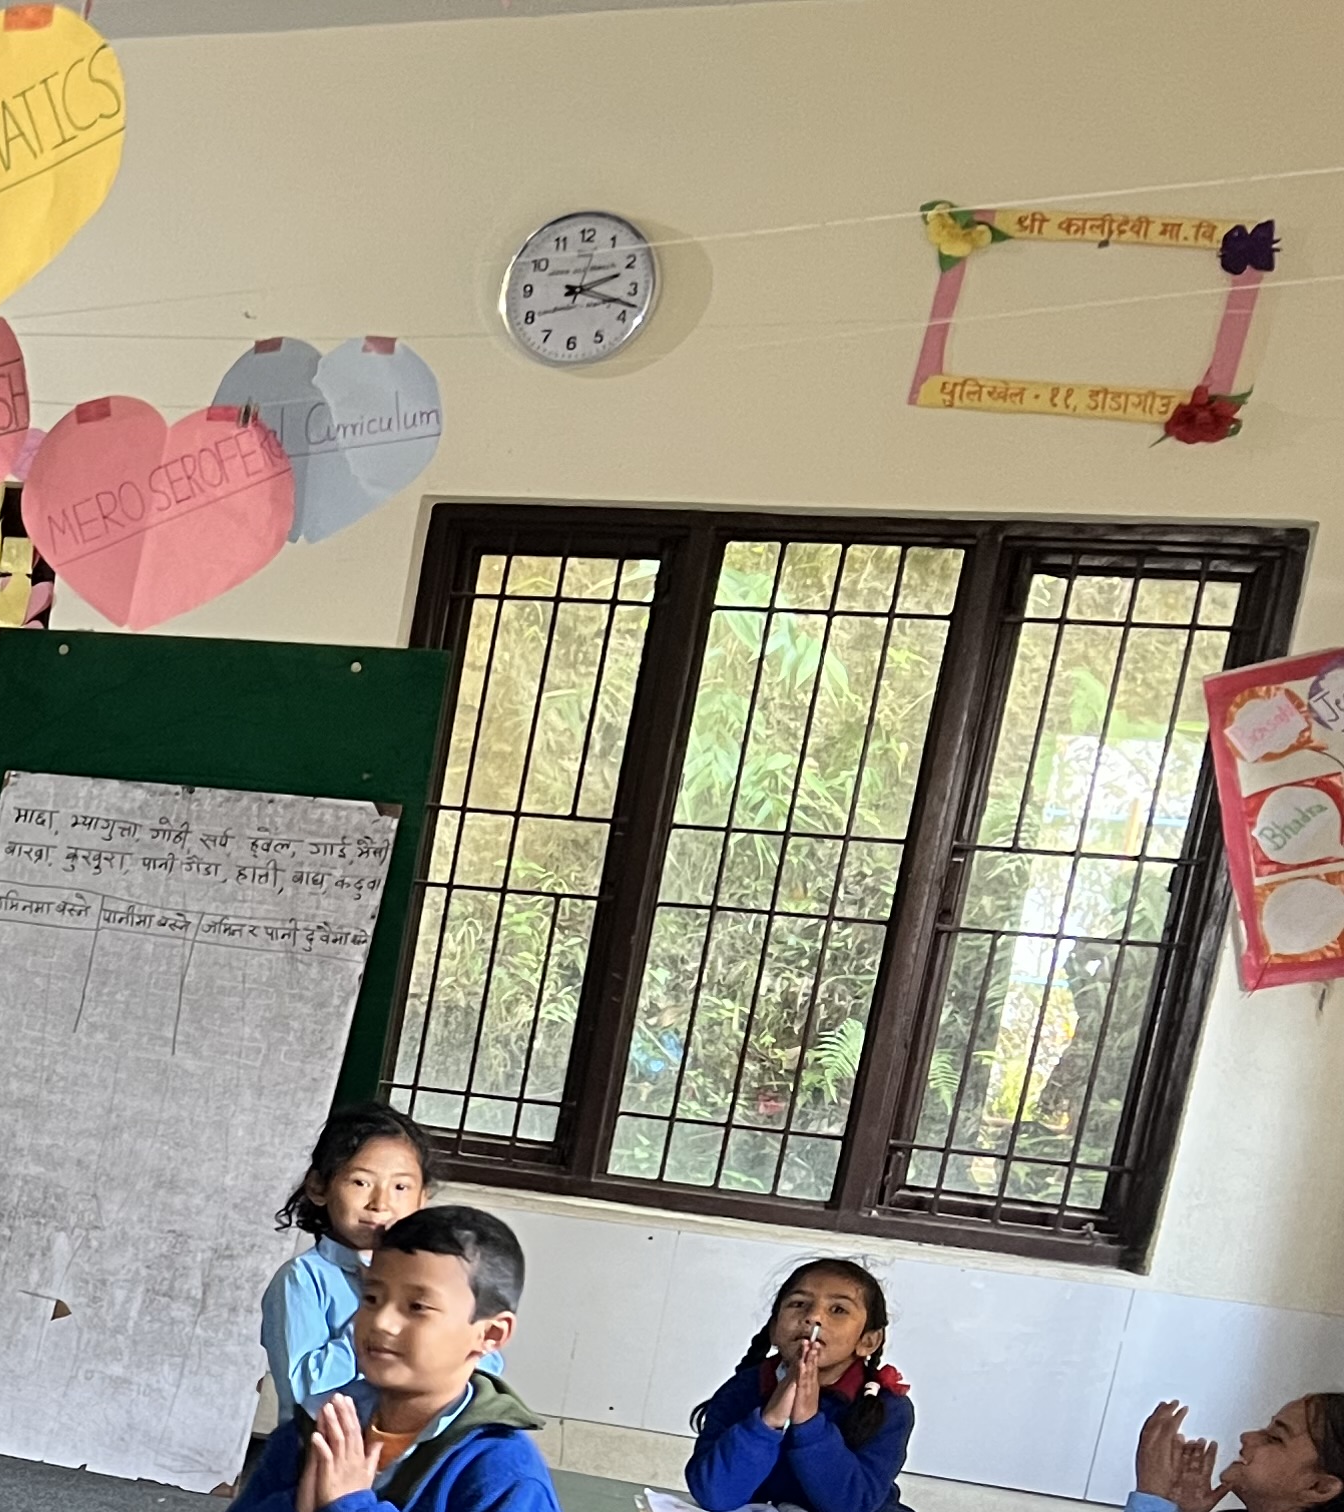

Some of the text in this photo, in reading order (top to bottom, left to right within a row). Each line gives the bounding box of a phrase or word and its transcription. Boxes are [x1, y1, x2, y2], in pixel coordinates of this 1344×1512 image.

[1016, 211, 1051, 236] श्री
[554, 236, 568, 252] 11
[579, 228, 597, 244] 12
[610, 235, 618, 249] 1
[531, 258, 549, 273] 10
[625, 254, 637, 270] 2
[522, 283, 534, 299] 9
[627, 282, 639, 297] 3
[524, 310, 536, 325] 8
[616, 310, 627, 324] 4
[540, 329, 553, 344] 7
[565, 336, 577, 351] 6
[593, 329, 605, 345] 5
[302, 395, 441, 446] Curriculum
[47, 479, 145, 556] MERO
[1256, 802, 1329, 852] Bhadra
